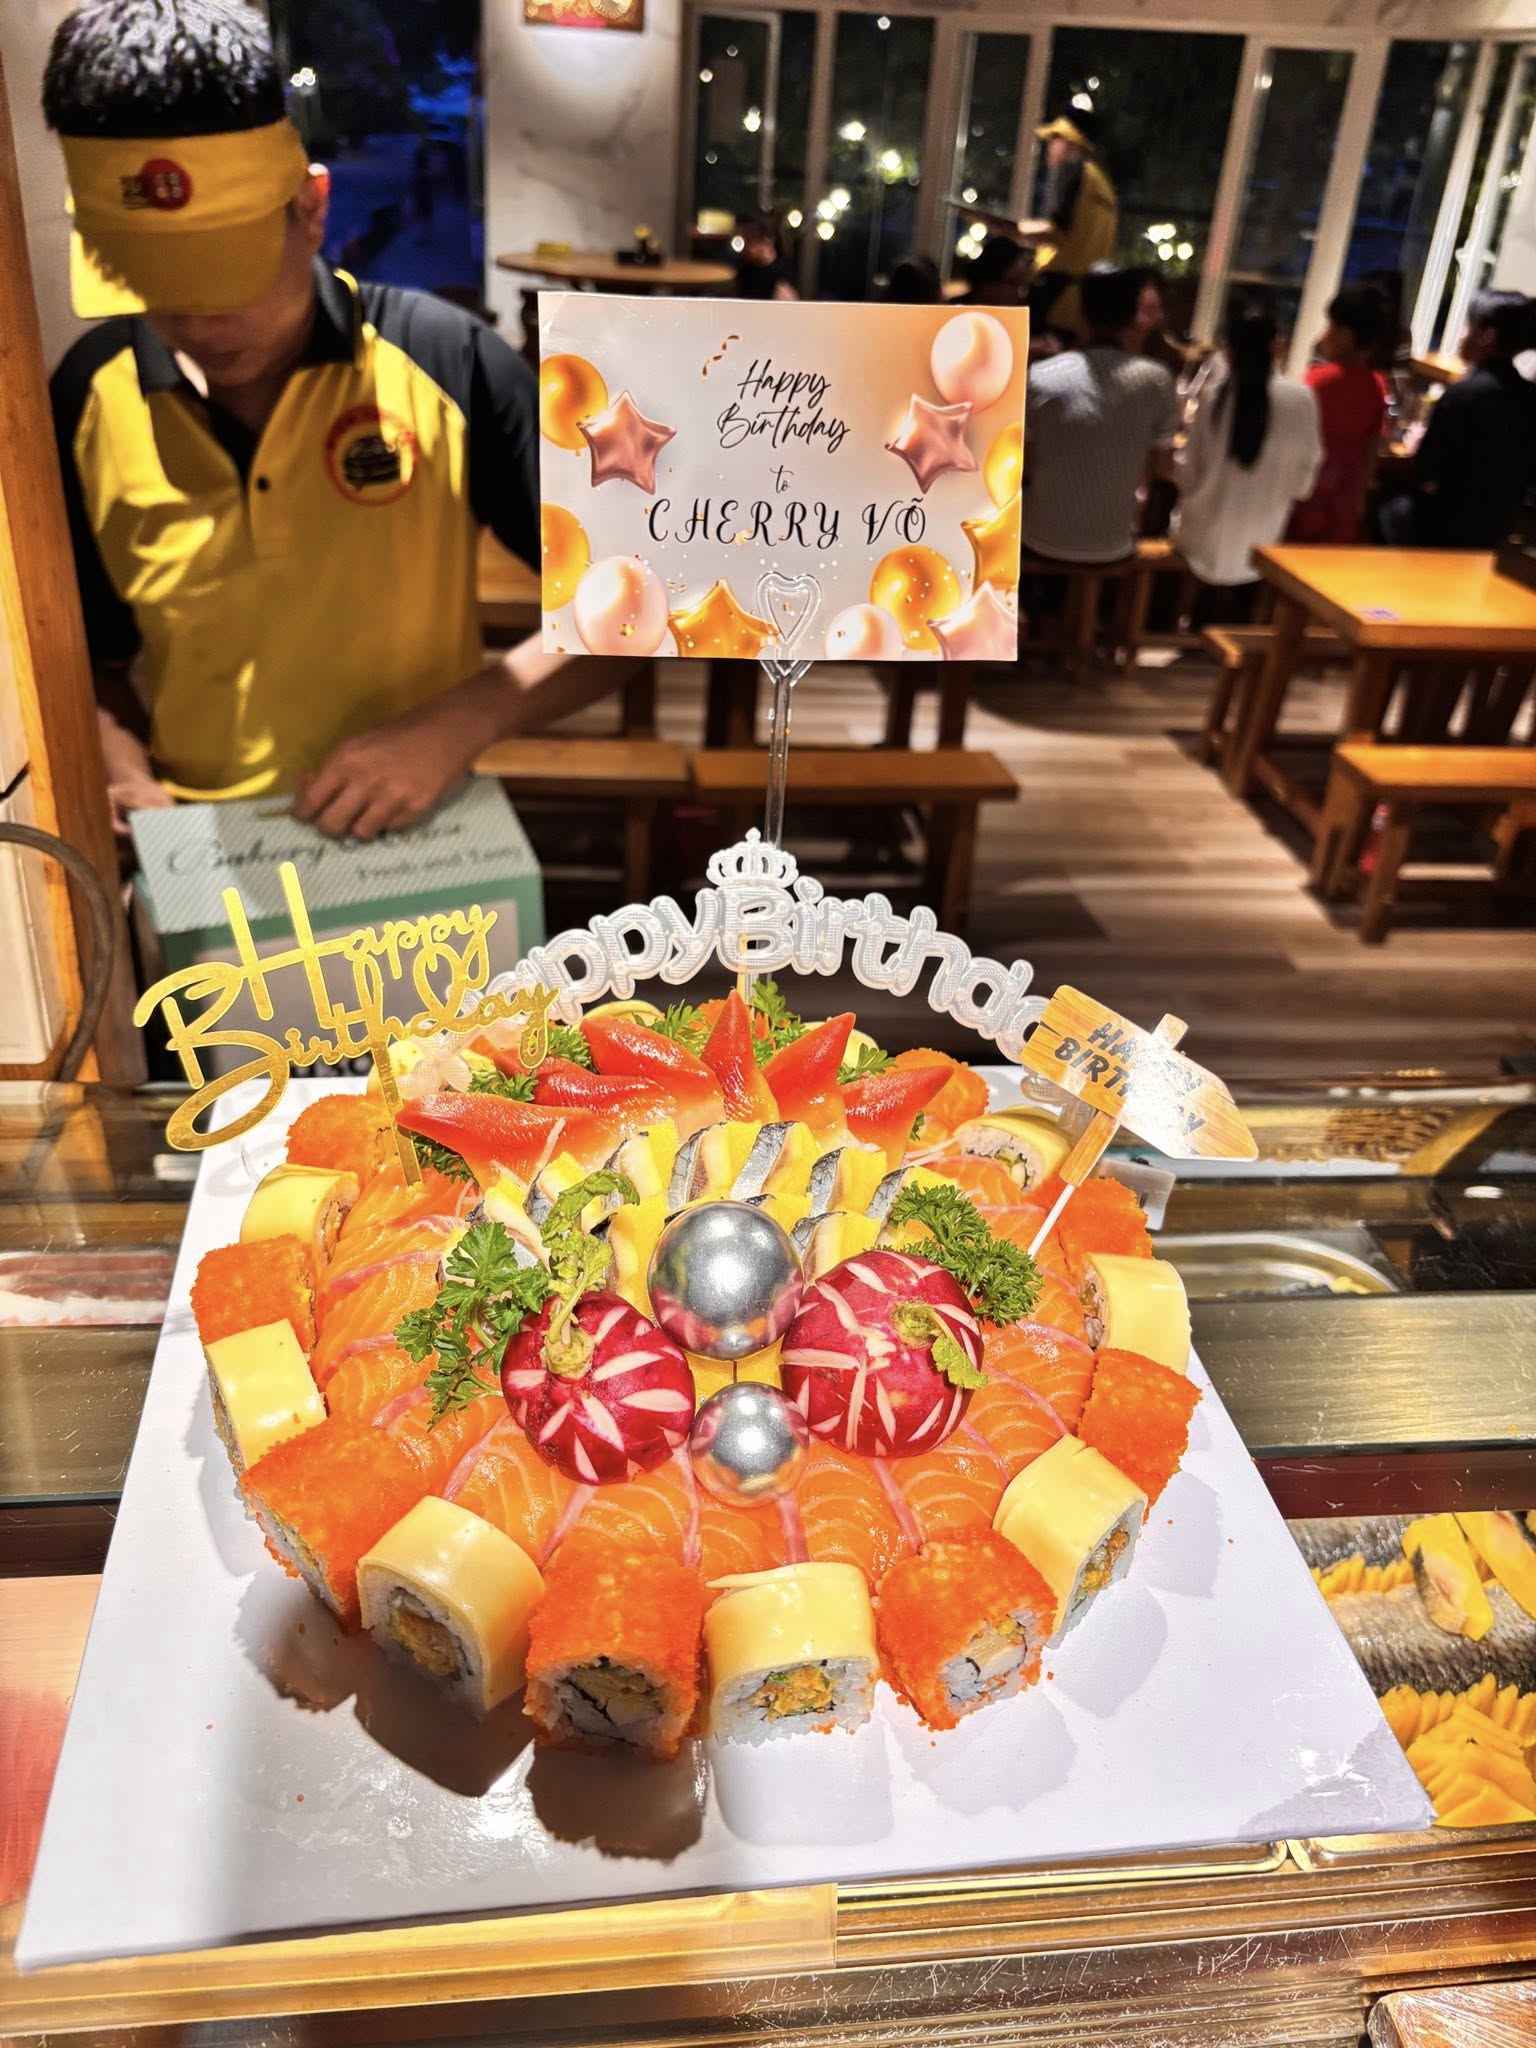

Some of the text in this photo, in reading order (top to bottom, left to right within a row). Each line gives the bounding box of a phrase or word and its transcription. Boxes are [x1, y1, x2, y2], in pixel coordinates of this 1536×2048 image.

[737, 359, 832, 409] Happy
[716, 402, 851, 454] Birthday
[769, 464, 794, 494] to
[648, 496, 927, 550] CHERRY VÕ
[186, 862, 498, 1028] Happy
[133, 942, 559, 1151] Birthday
